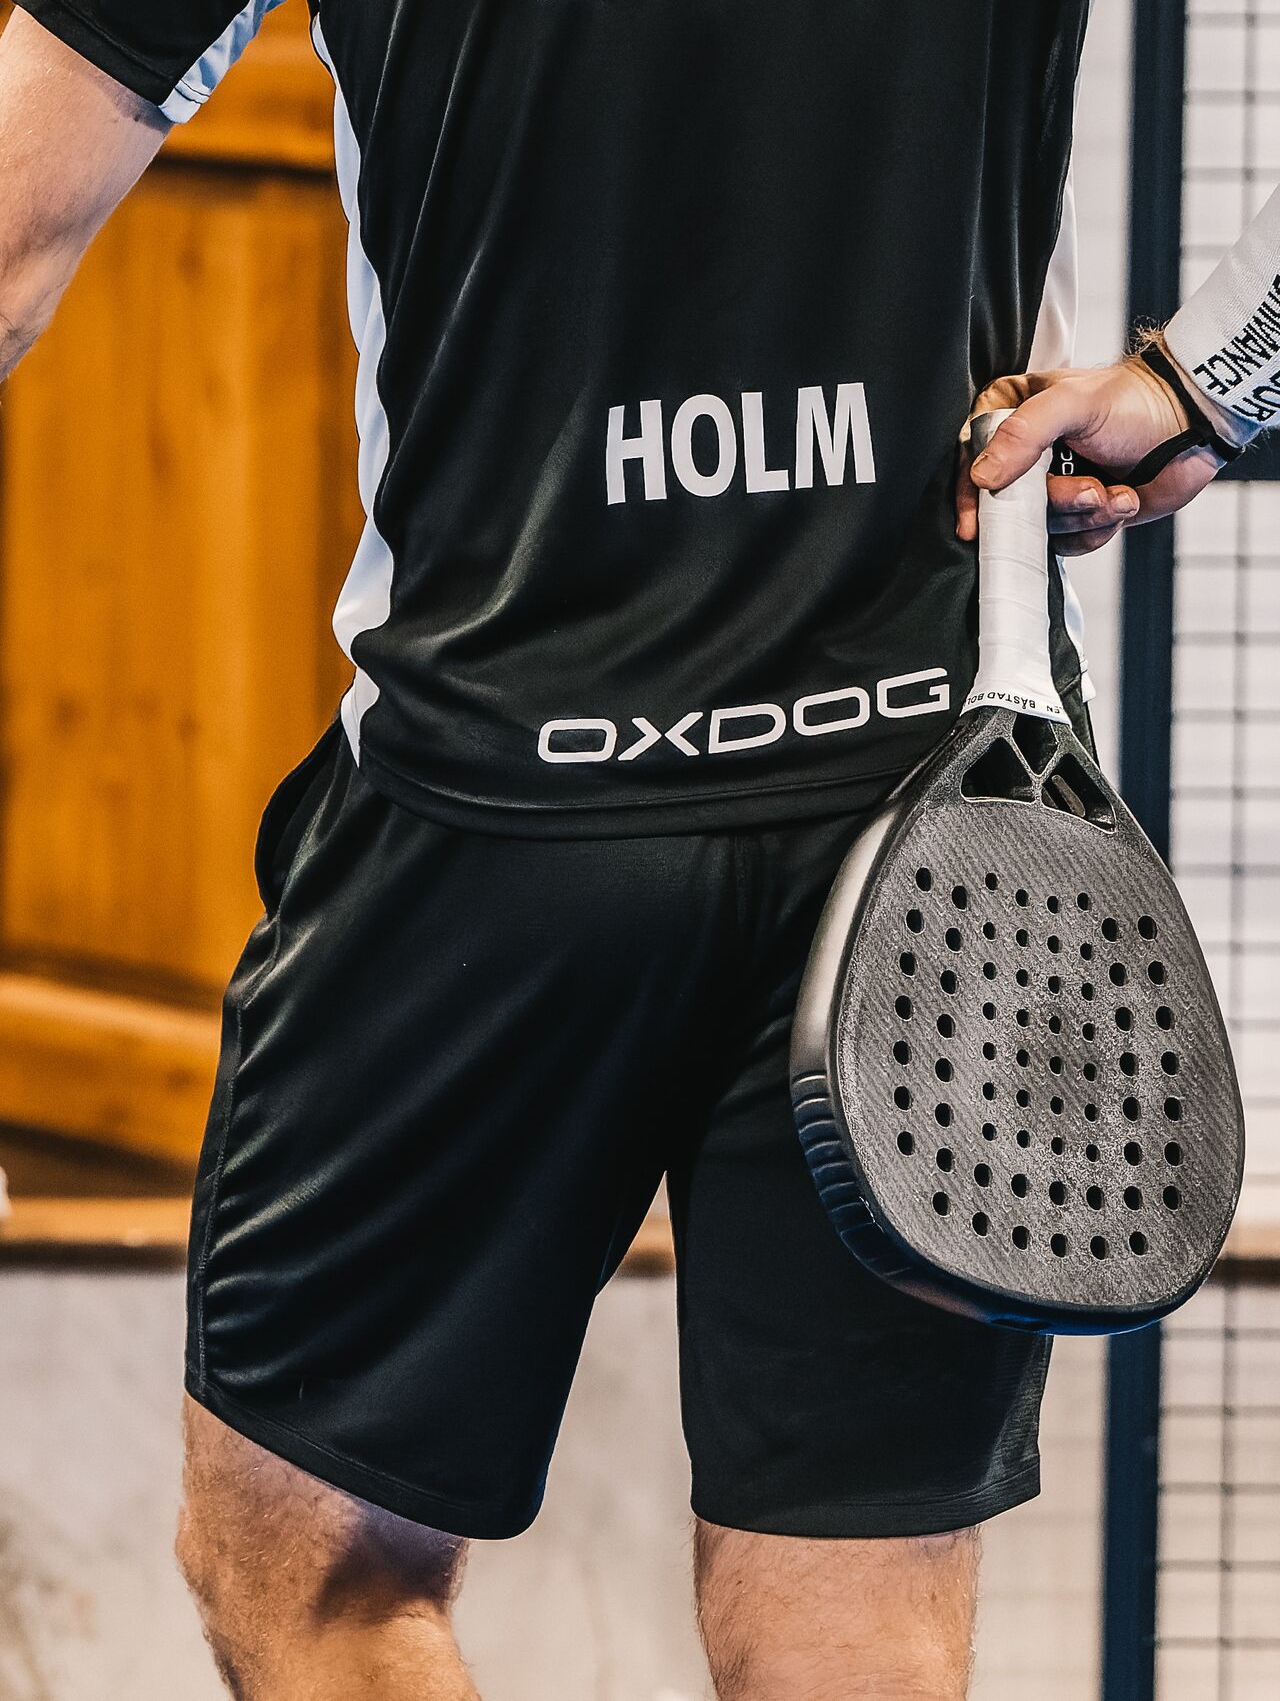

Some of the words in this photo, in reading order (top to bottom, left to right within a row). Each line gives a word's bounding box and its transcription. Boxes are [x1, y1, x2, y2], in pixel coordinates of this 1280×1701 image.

[606, 382, 876, 505] HOLM
[537, 668, 950, 763] OXDOG
[987, 691, 1036, 710] BÅSTAD
